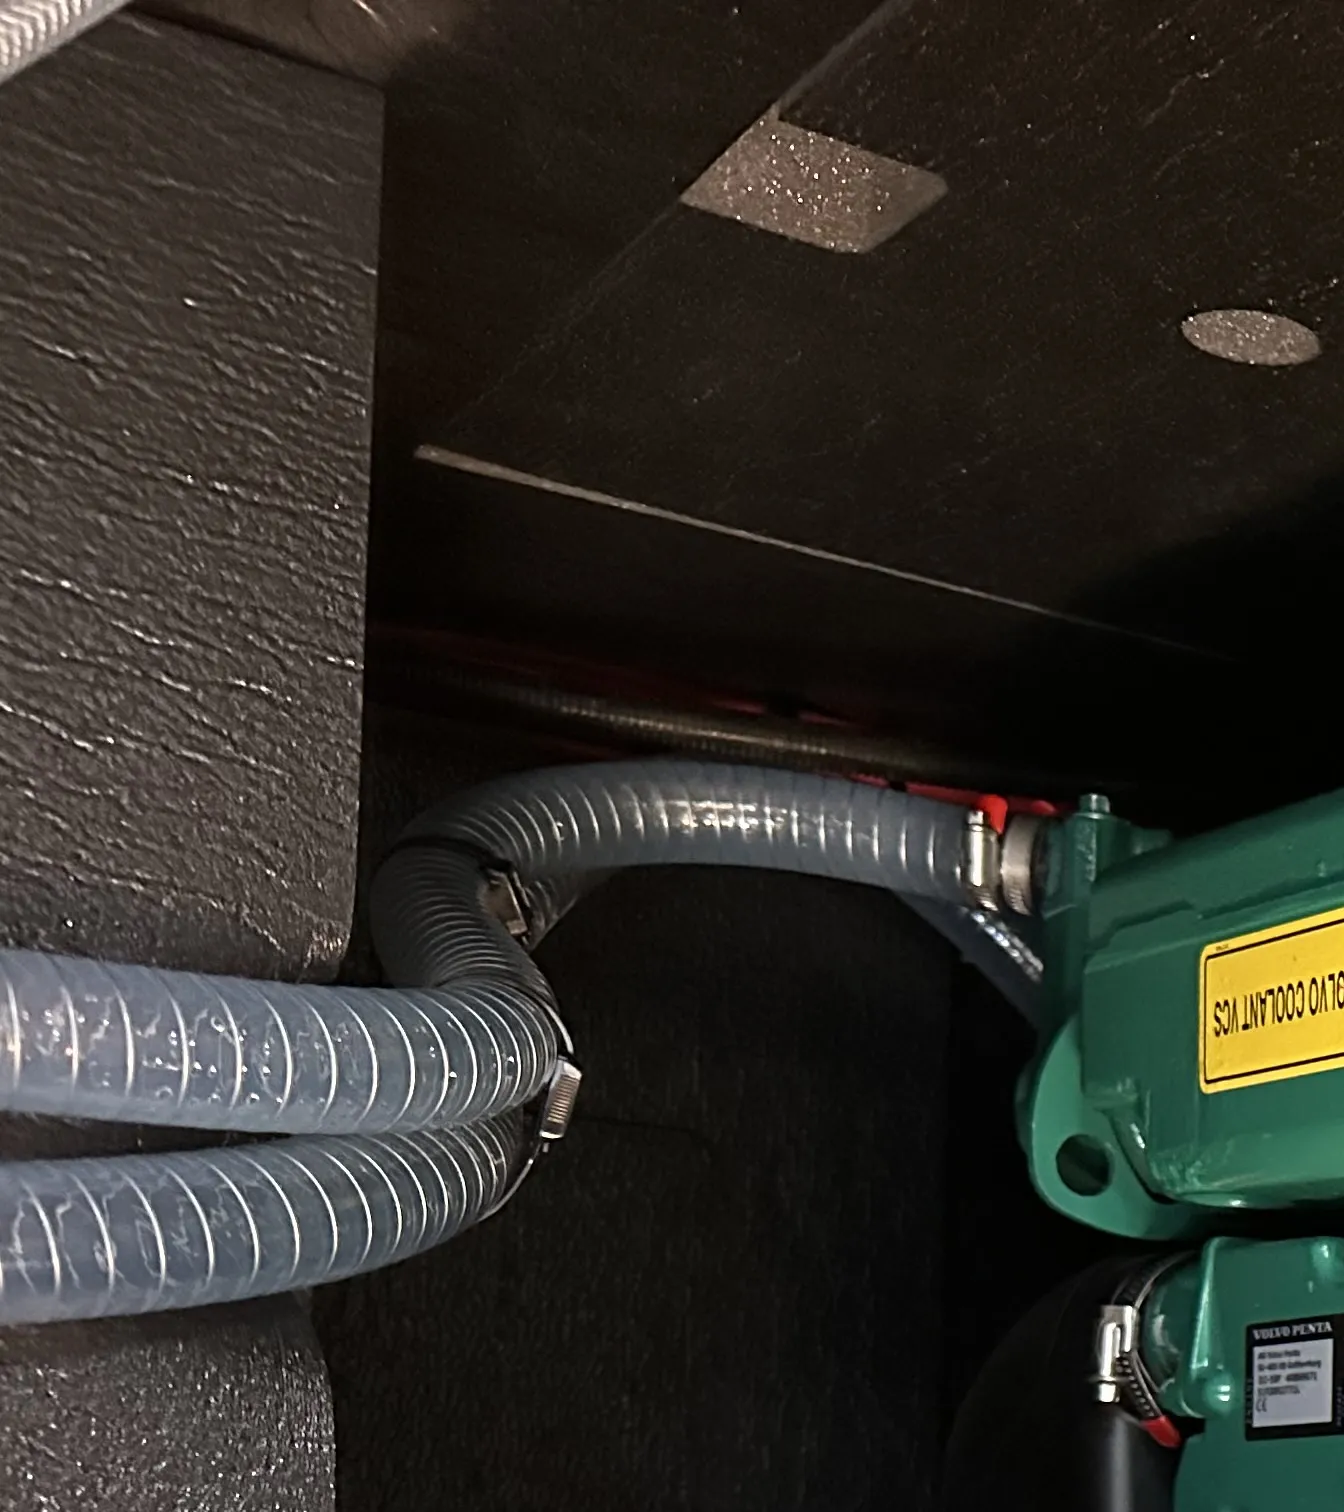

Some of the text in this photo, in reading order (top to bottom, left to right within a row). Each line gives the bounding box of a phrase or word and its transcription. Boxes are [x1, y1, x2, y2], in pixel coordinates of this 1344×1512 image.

[1213, 996, 1239, 1037] VCS
[1242, 980, 1305, 1031] COOLANT
[1252, 1321, 1333, 1340] VOLVO PENTA
